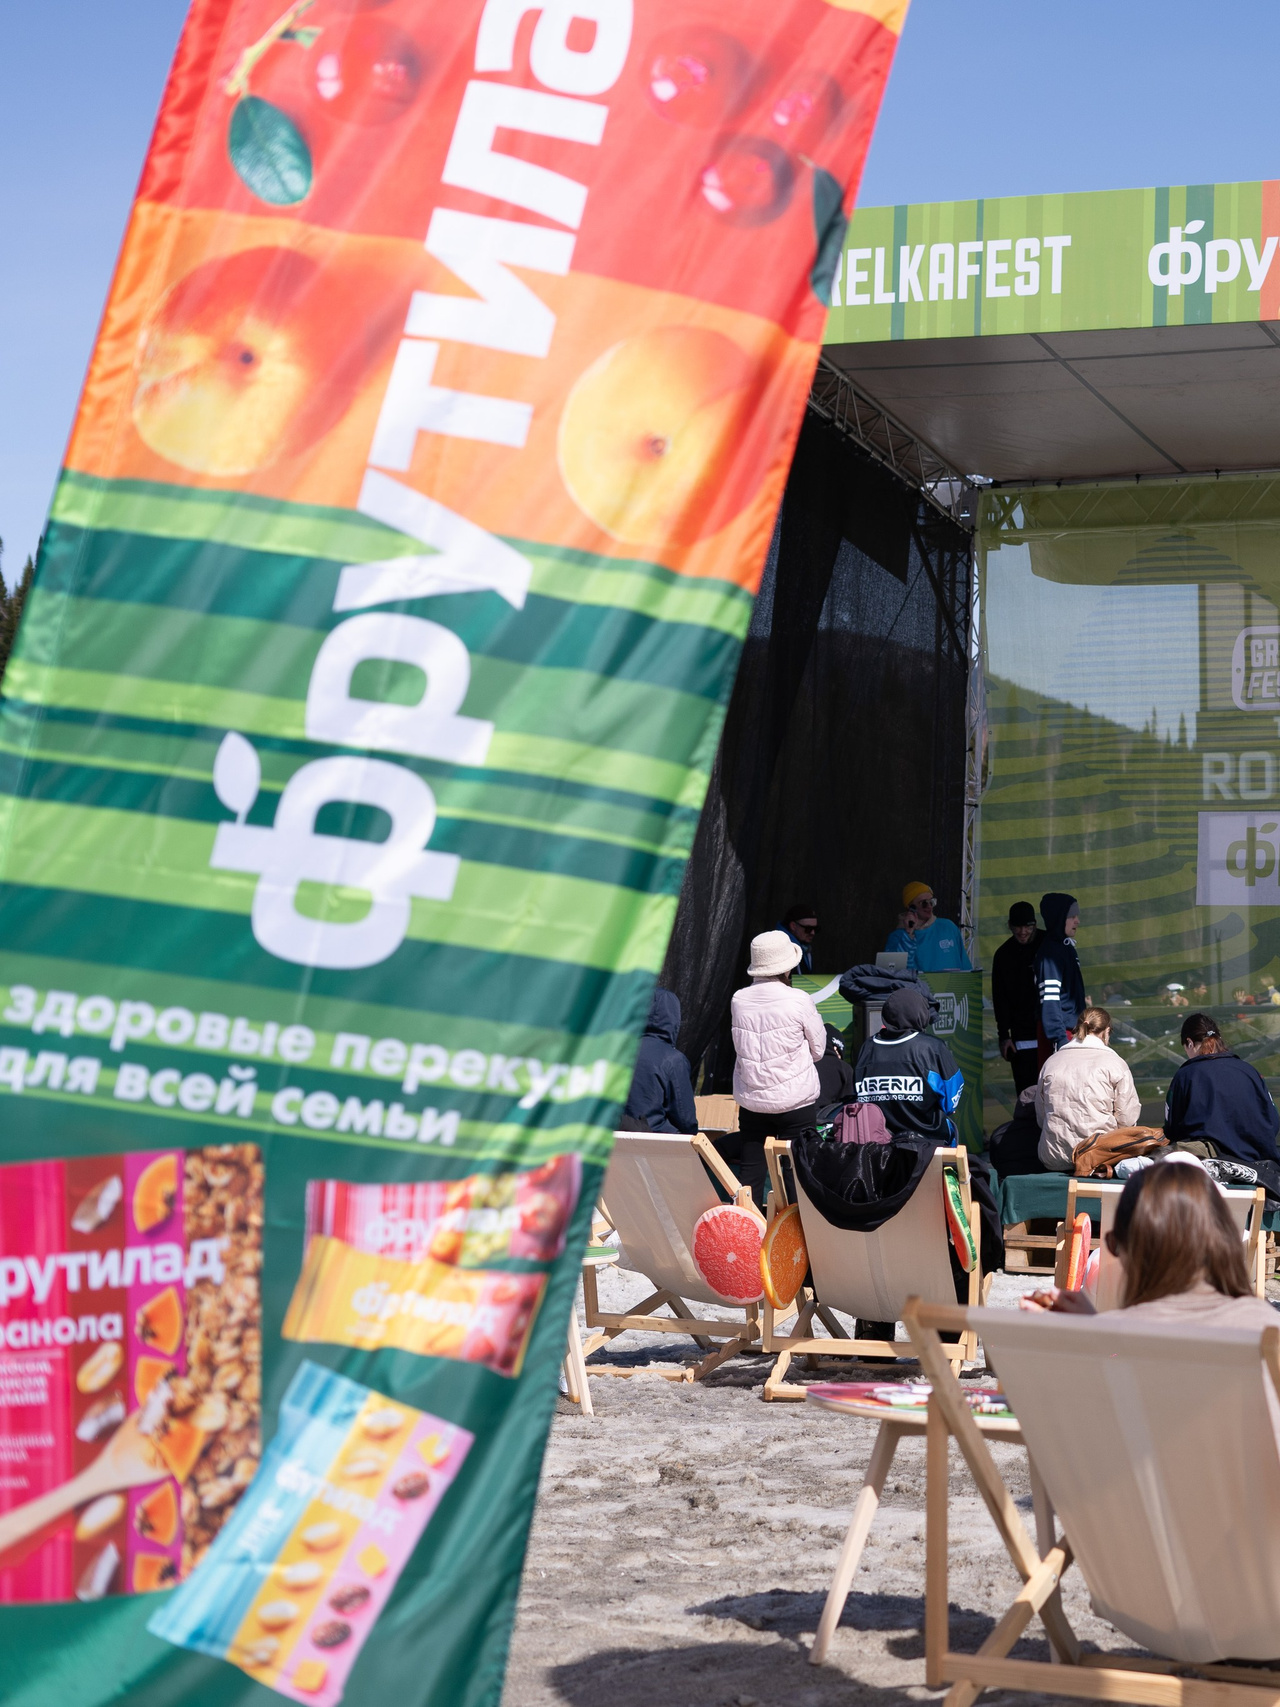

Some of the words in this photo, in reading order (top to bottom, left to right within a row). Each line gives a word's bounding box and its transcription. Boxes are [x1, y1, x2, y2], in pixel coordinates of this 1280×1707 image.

[9, 984, 316, 1064] здоровые
[0, 1045, 102, 1095] для
[114, 1061, 258, 1118] всей
[270, 1086, 462, 1146] семьи
